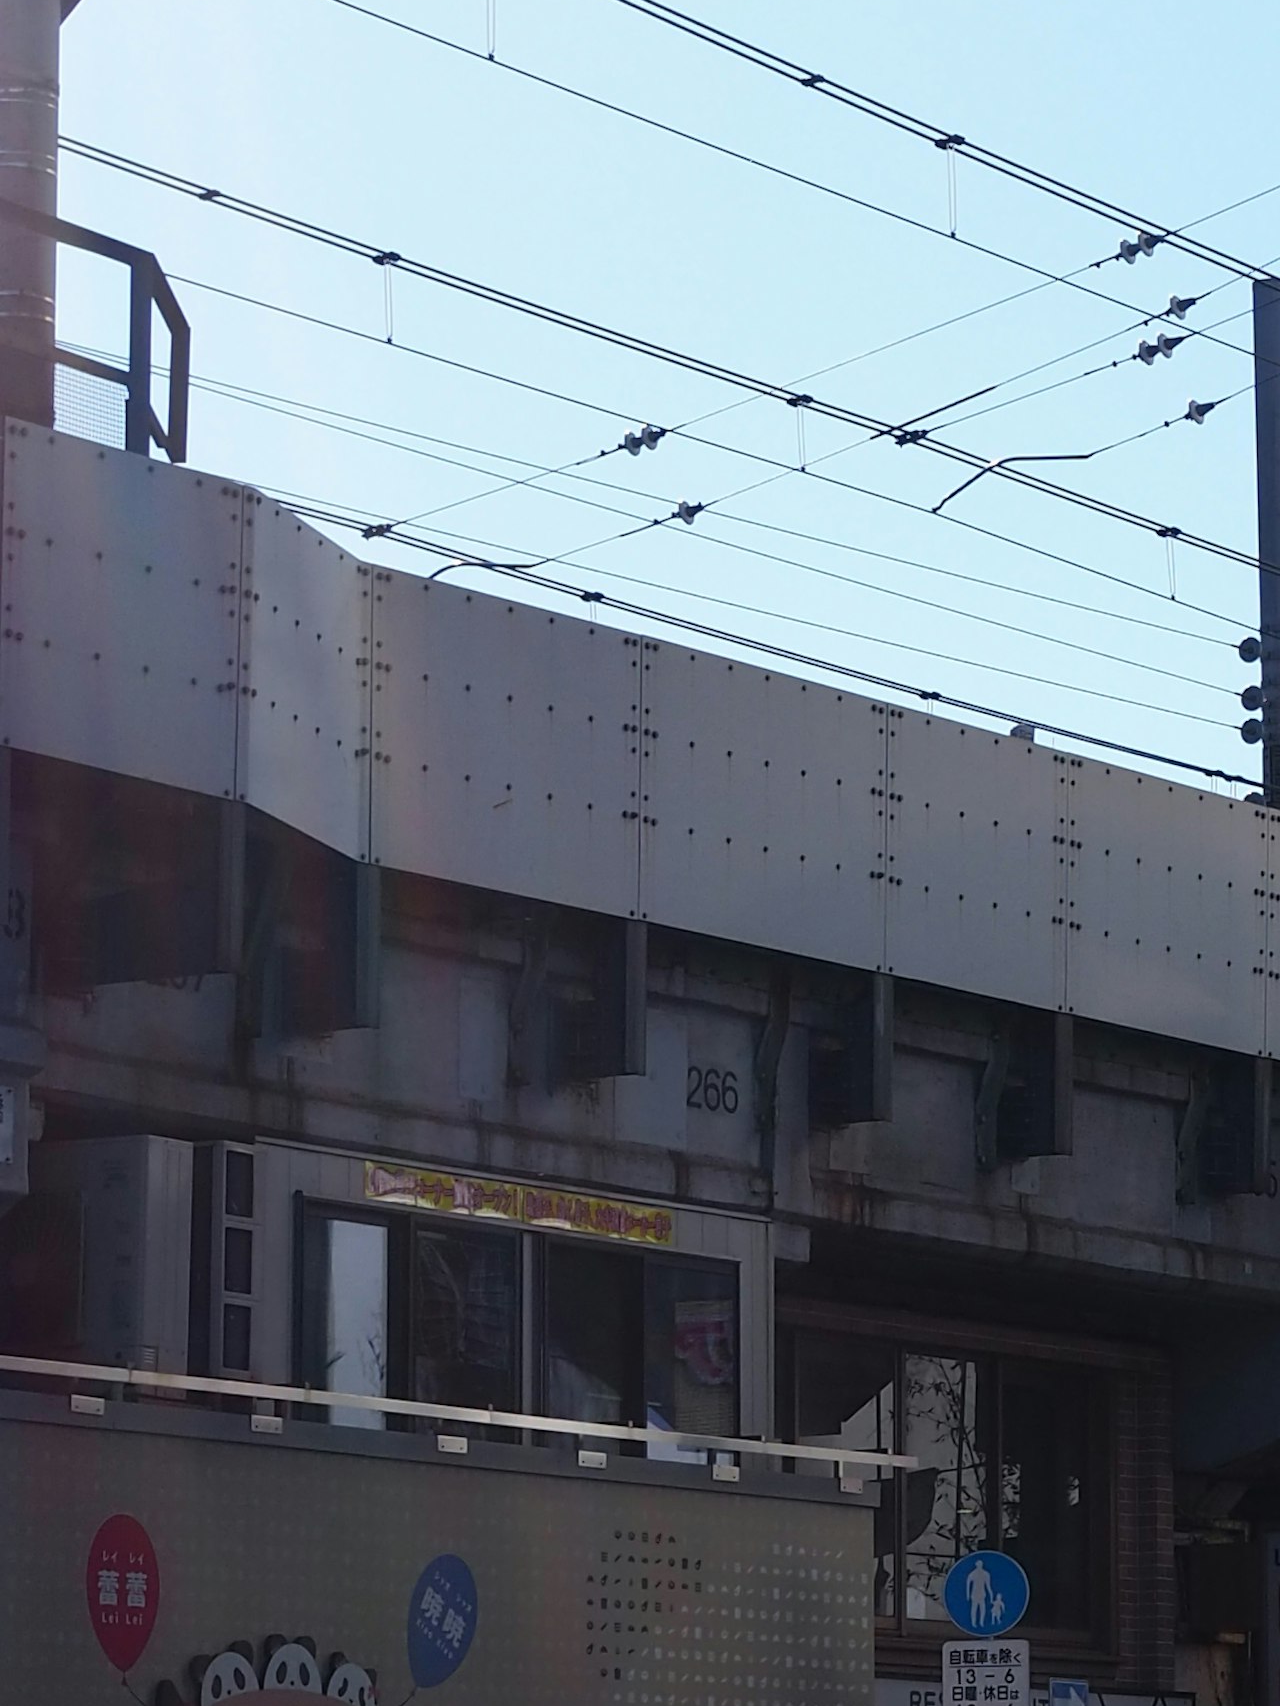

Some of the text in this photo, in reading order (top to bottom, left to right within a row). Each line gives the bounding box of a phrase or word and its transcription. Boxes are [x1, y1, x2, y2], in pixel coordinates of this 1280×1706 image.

[687, 1065, 739, 1116] 266
[101, 1611, 143, 1627] Lei Lei
[949, 1649, 1021, 1665] 自転車を除く
